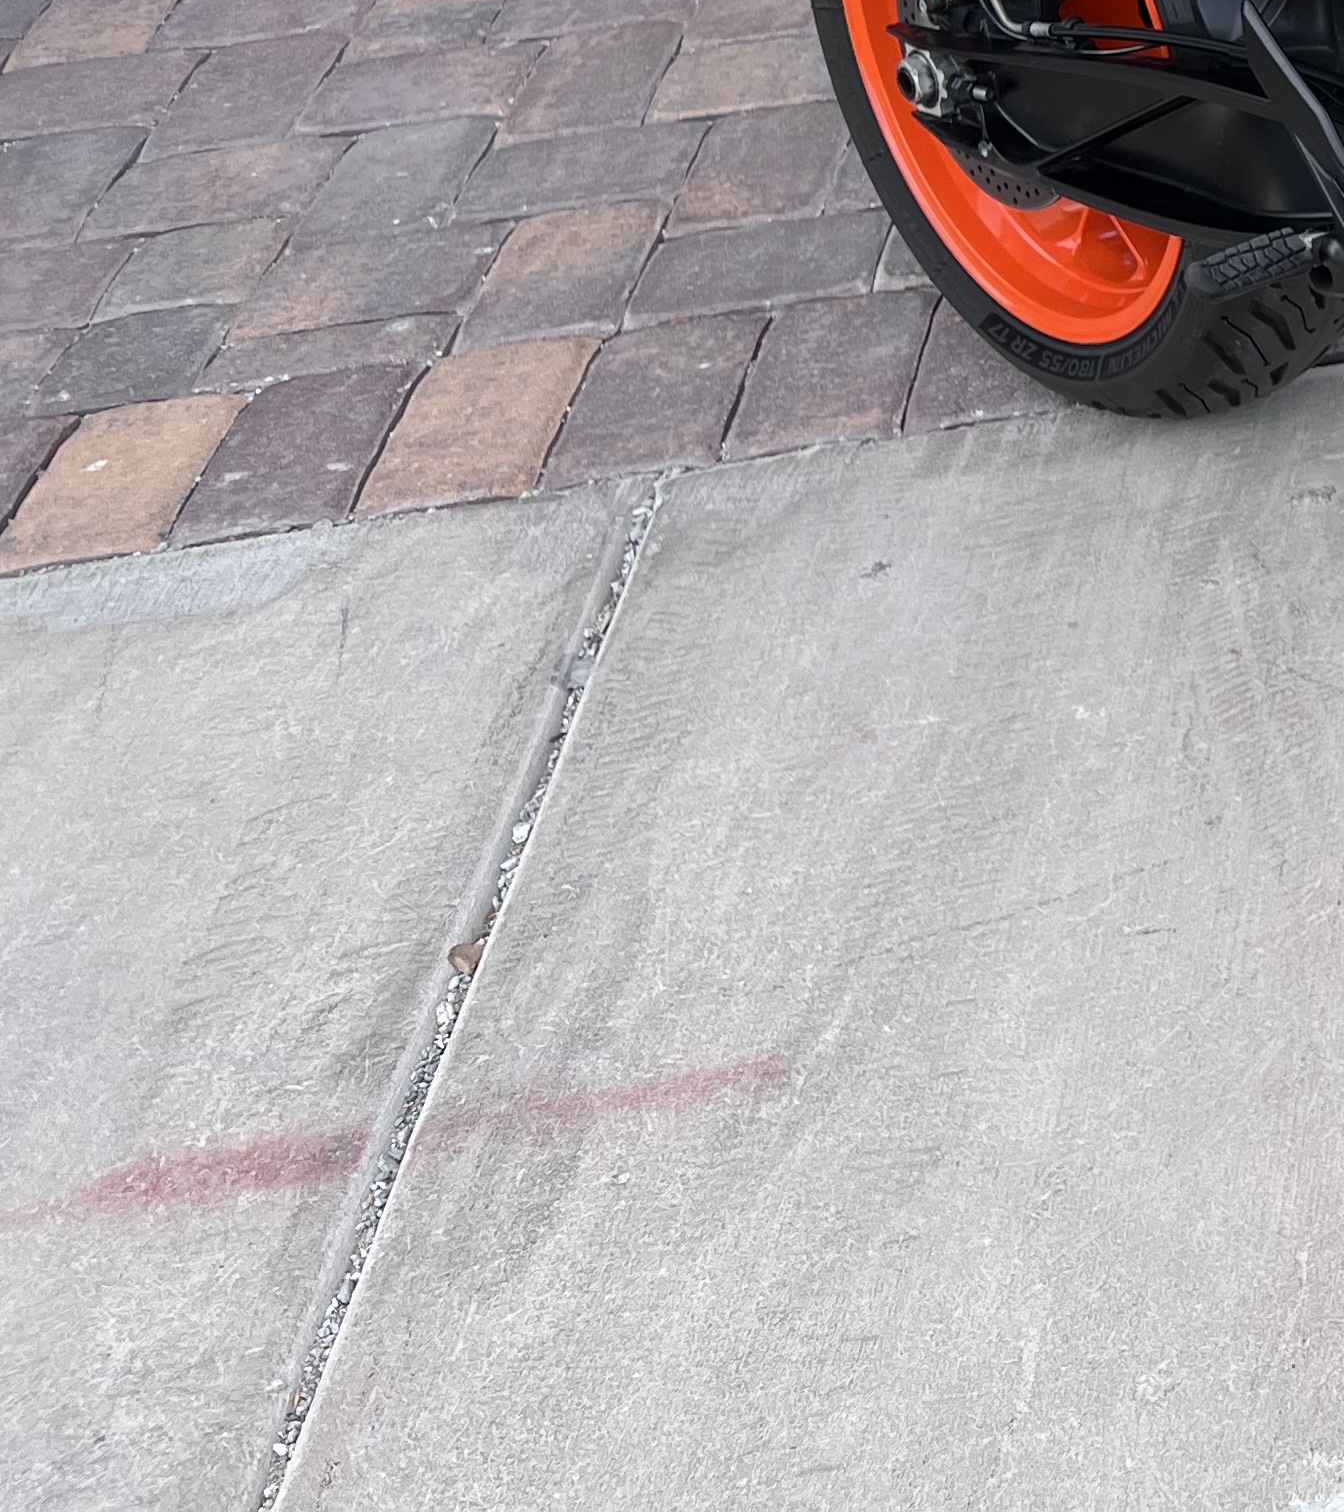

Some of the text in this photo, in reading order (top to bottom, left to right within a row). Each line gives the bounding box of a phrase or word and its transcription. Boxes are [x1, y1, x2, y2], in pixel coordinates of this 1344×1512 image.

[987, 322, 1095, 378] 180/55 ZR 17
[1107, 308, 1174, 375] MICHELIN
